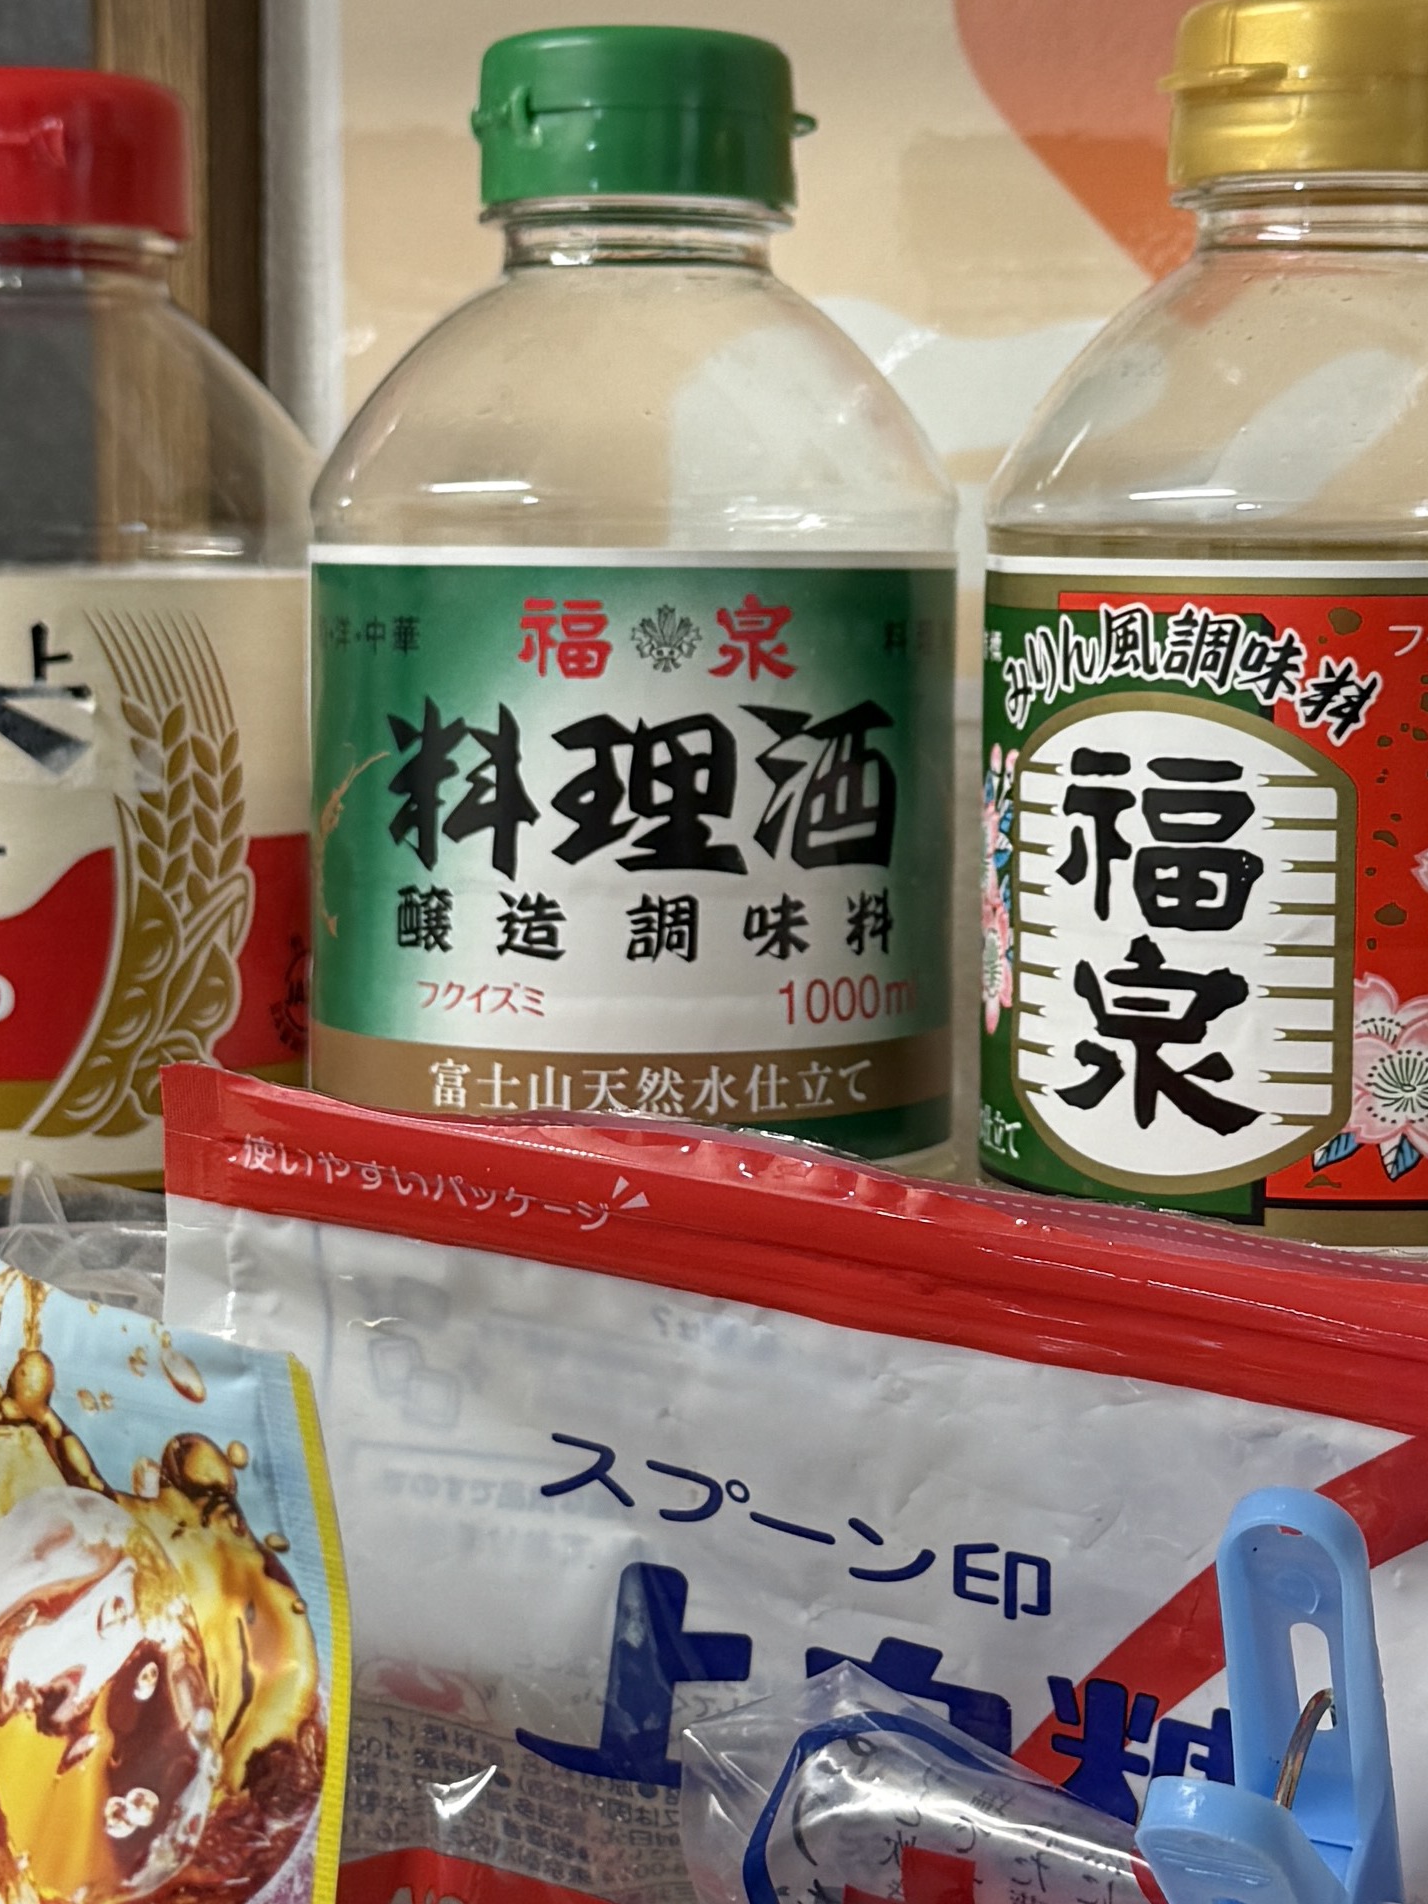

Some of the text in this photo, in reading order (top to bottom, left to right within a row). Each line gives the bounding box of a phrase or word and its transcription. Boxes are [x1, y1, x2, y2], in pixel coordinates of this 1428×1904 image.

[1005, 605, 1380, 745] みりん風調味料
[387, 696, 896, 881] 料理酒
[396, 887, 893, 964] 醸造調味料
[1055, 748, 1269, 1137] 福泉
[417, 979, 545, 1018] フクイズミ
[429, 1058, 873, 1116] 富士山天然水仕立て
[243, 1134, 611, 1231] 使いやすいパッケージ
[539, 1433, 1052, 1620] スプーン印
